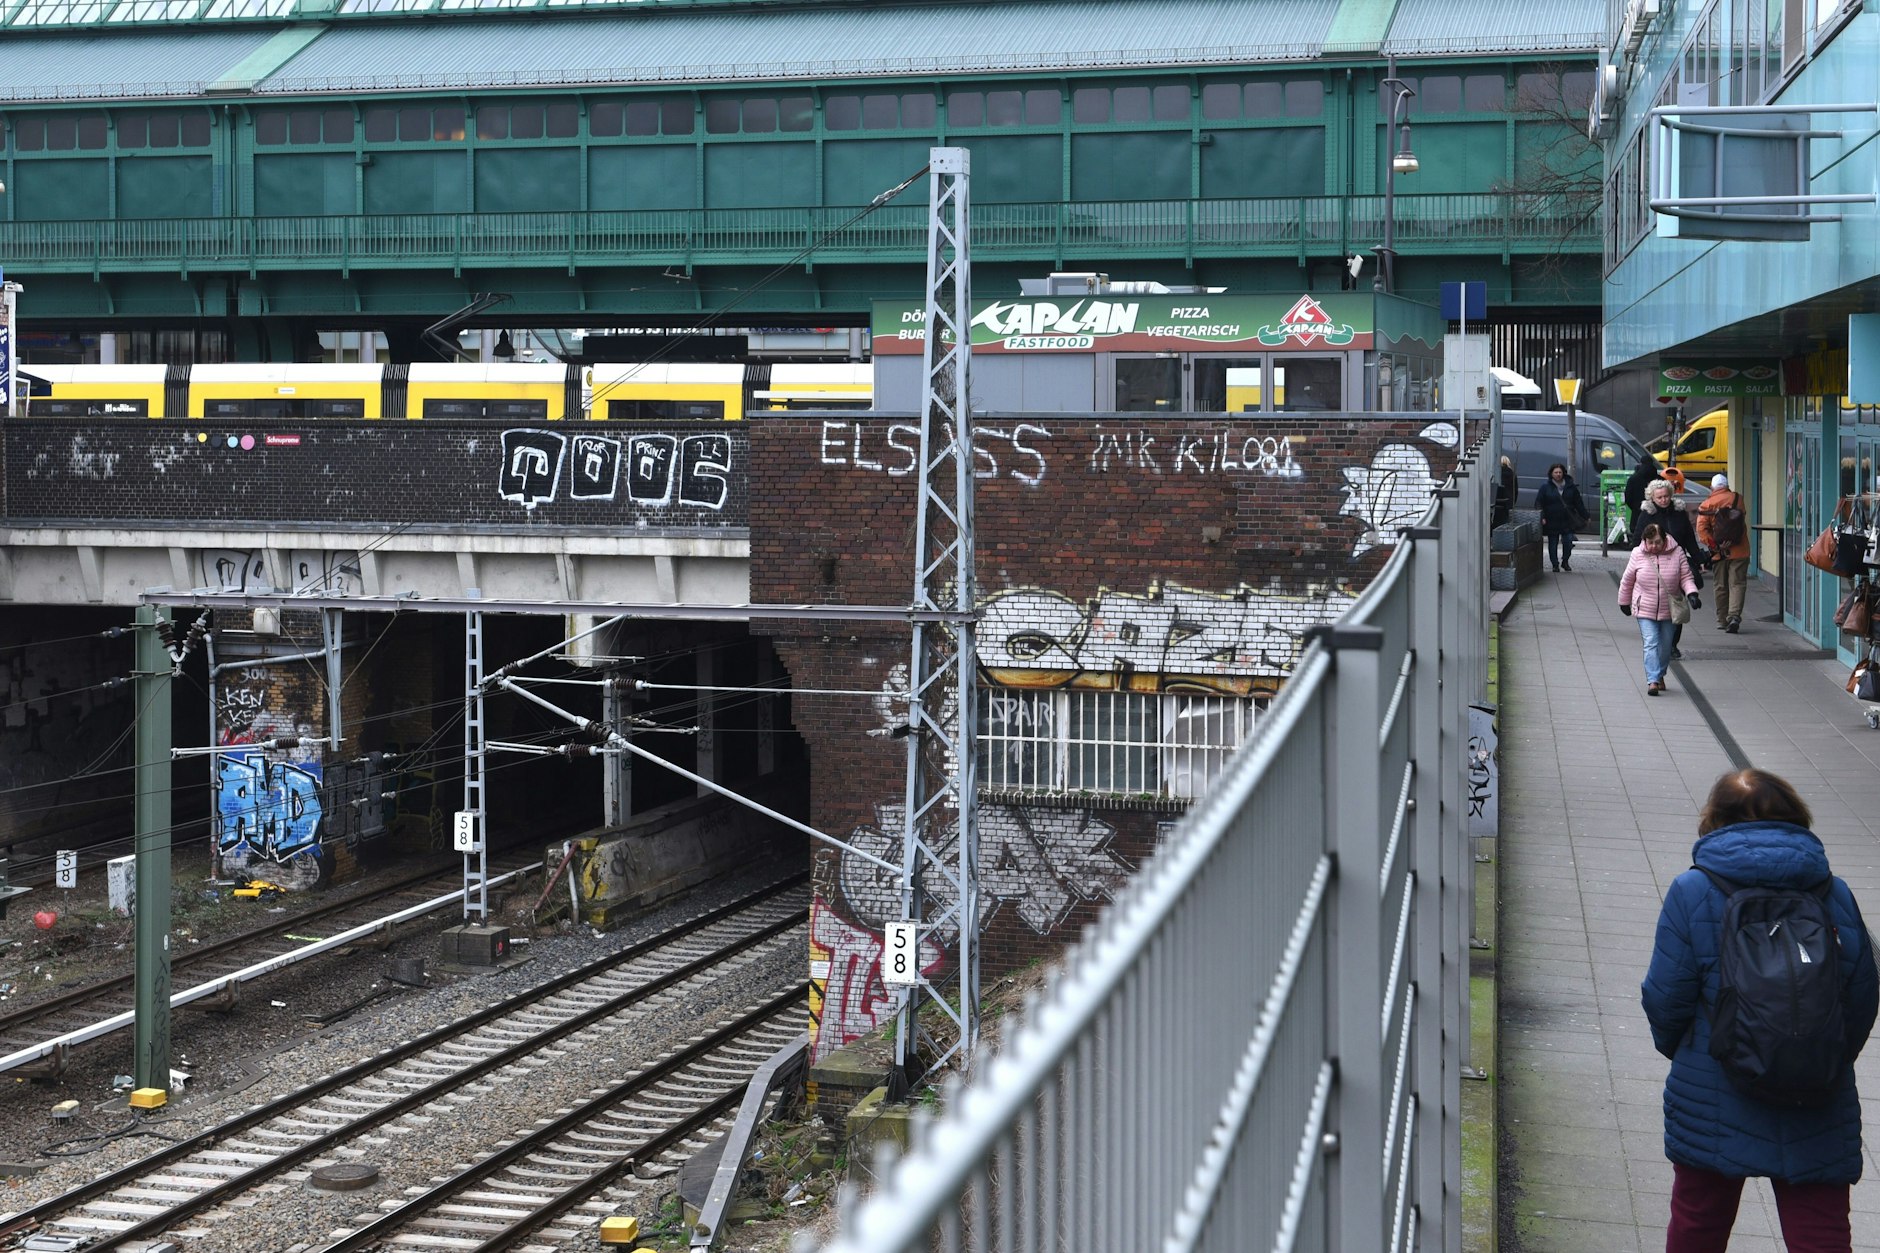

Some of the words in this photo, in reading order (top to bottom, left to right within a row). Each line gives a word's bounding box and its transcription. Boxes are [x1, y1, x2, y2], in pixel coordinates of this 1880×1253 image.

[971, 299, 1139, 337] KAPLAN
[1170, 307, 1210, 319] PIZZA
[898, 328, 951, 341] BURR
[1146, 324, 1240, 337] VEGETARISCH
[1278, 322, 1334, 335] KAPLAN
[1008, 336, 1090, 349] FASTFOOD
[1665, 385, 1692, 394] PIZZA
[1704, 385, 1733, 393] PASTA
[1745, 385, 1776, 393] SALAT
[266, 435, 300, 444] Schnupreme
[460, 816, 468, 829] 5
[460, 832, 467, 845] 8
[62, 853, 71, 867] 5
[62, 869, 70, 882] 8
[894, 929, 906, 949] 5
[894, 953, 906, 974] 8
